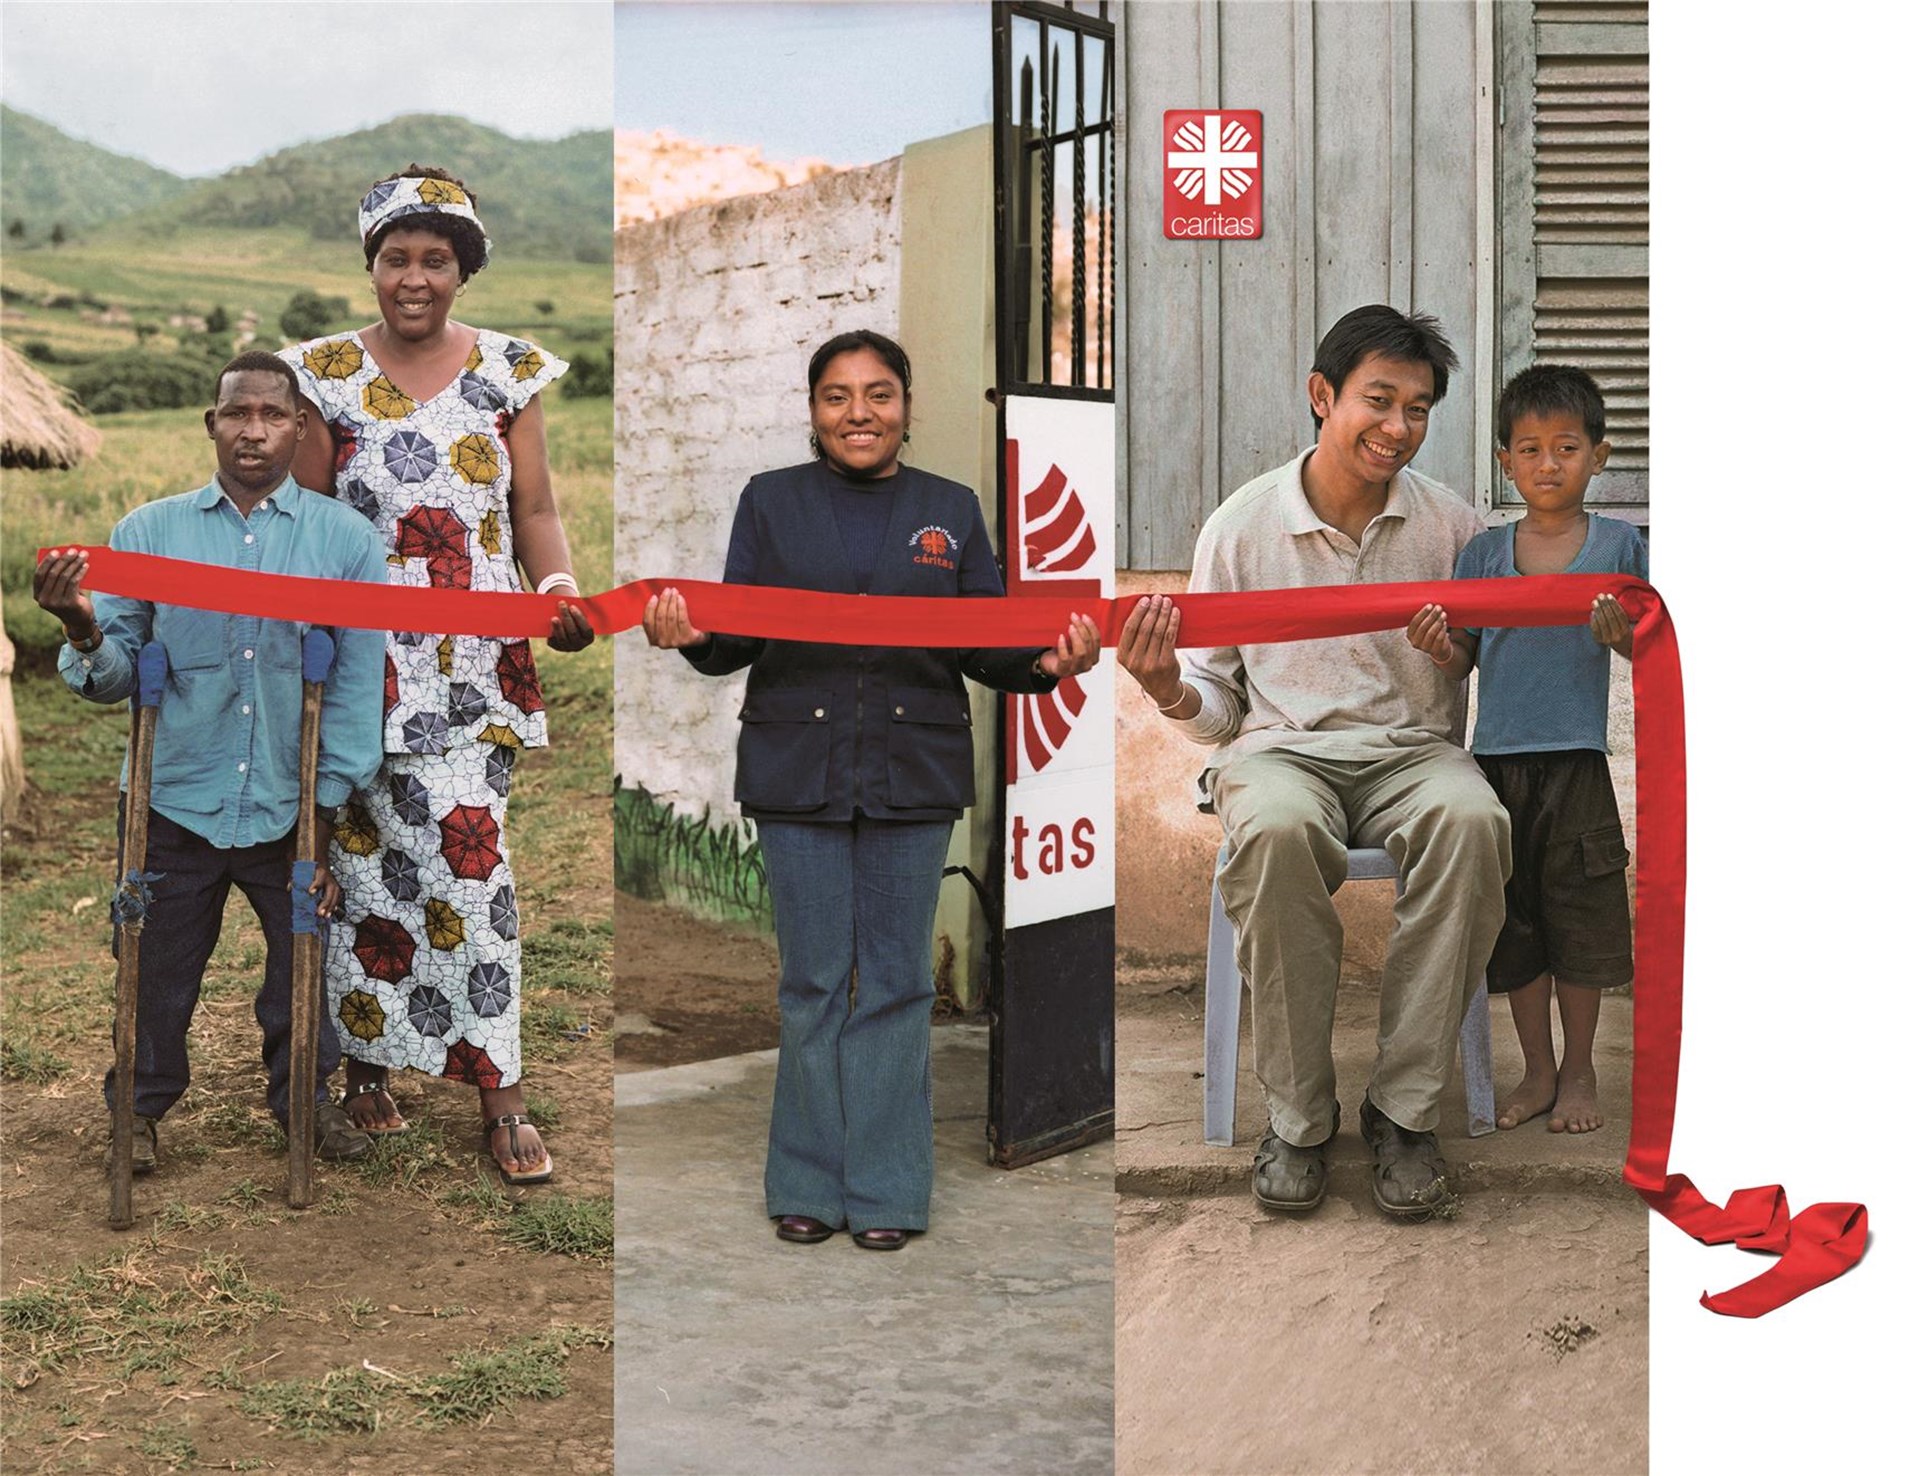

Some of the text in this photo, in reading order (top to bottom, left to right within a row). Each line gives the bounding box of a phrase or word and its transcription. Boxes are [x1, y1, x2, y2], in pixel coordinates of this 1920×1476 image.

[1171, 211, 1255, 236] caritas
[908, 525, 958, 550] Voluntariado
[1012, 816, 1095, 880] tas
